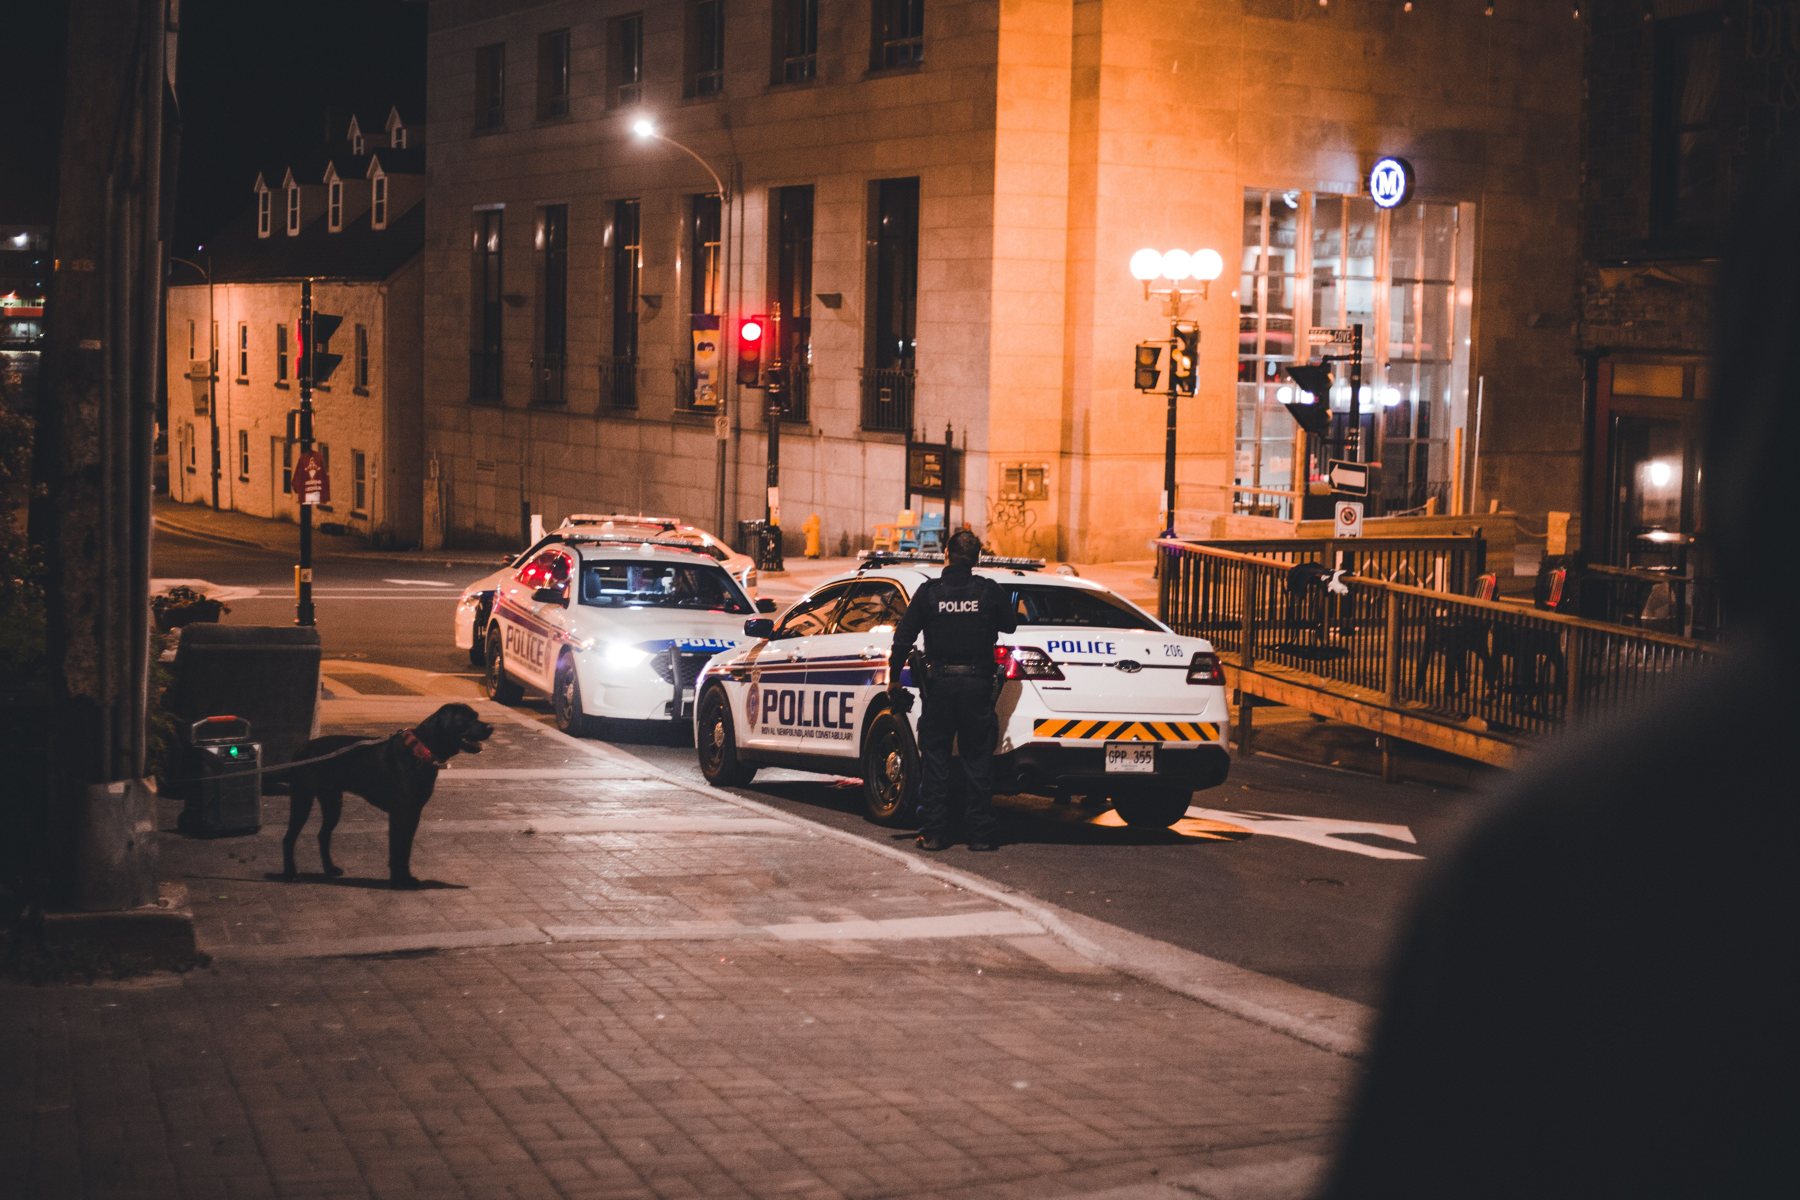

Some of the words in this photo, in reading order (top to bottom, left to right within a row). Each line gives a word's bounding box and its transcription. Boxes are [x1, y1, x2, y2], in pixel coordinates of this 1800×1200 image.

[1378, 169, 1398, 196] M
[938, 600, 979, 613] POLICE
[505, 624, 545, 669] POLICE
[674, 638, 742, 650] POLIC
[1047, 640, 1118, 655] POLICE
[1163, 644, 1184, 657] 206
[761, 689, 855, 729] POLICE
[761, 727, 776, 736] ROYAL
[776, 728, 815, 739] NEWFOUNDLAND
[815, 730, 854, 742] CONSTABULARY
[1108, 750, 1128, 764] GPP
[1133, 750, 1152, 764] 355
